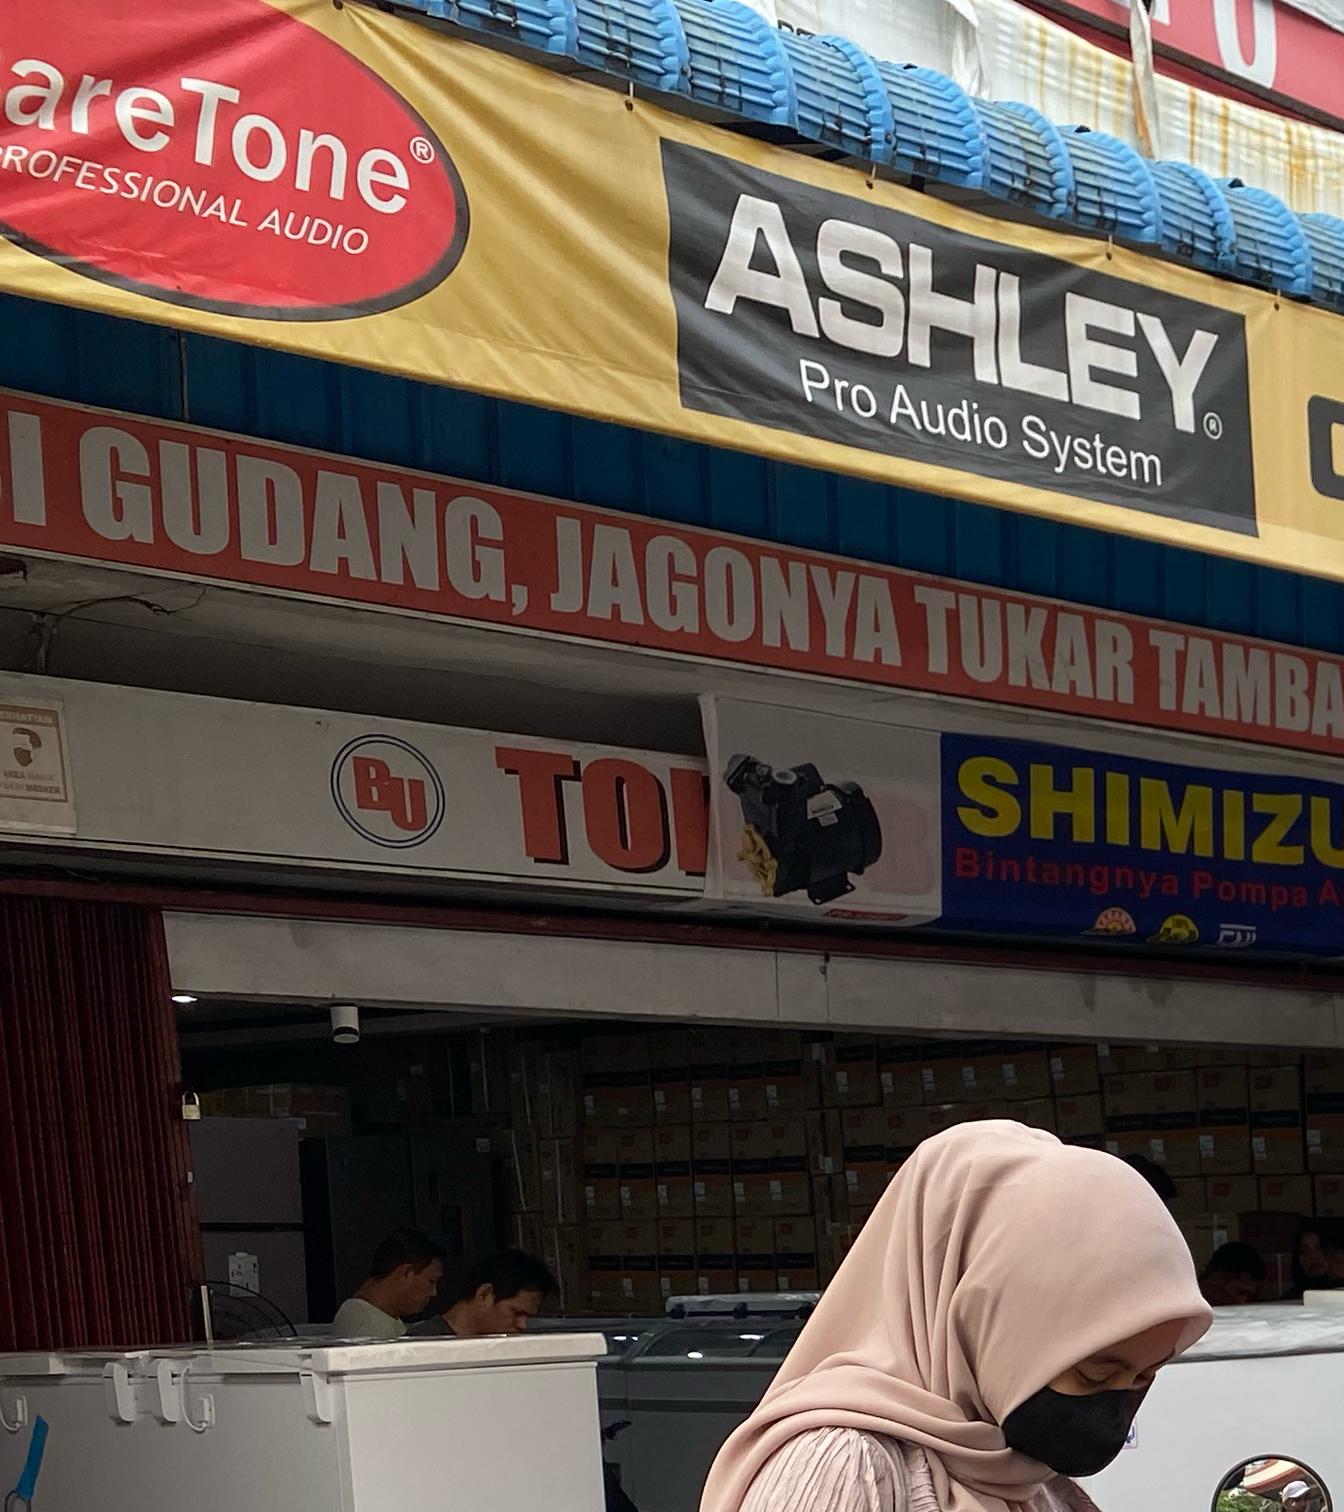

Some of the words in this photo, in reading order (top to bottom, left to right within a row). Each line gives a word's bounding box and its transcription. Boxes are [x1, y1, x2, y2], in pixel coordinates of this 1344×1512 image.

[0, 57, 411, 215] areTone
[257, 208, 370, 257] AUDIO
[703, 193, 1220, 434] ASHLEY
[799, 358, 878, 420] Pro
[889, 384, 1009, 451] Audio
[1021, 412, 1164, 488] System
[78, 424, 528, 617] GUDANG,
[549, 514, 903, 668] JAGONYA
[913, 583, 1135, 705] TUKAR
[0, 711, 53, 724] ERHATIAN
[953, 846, 1181, 900] Bintangnya
[1190, 861, 1309, 914] Pompa
